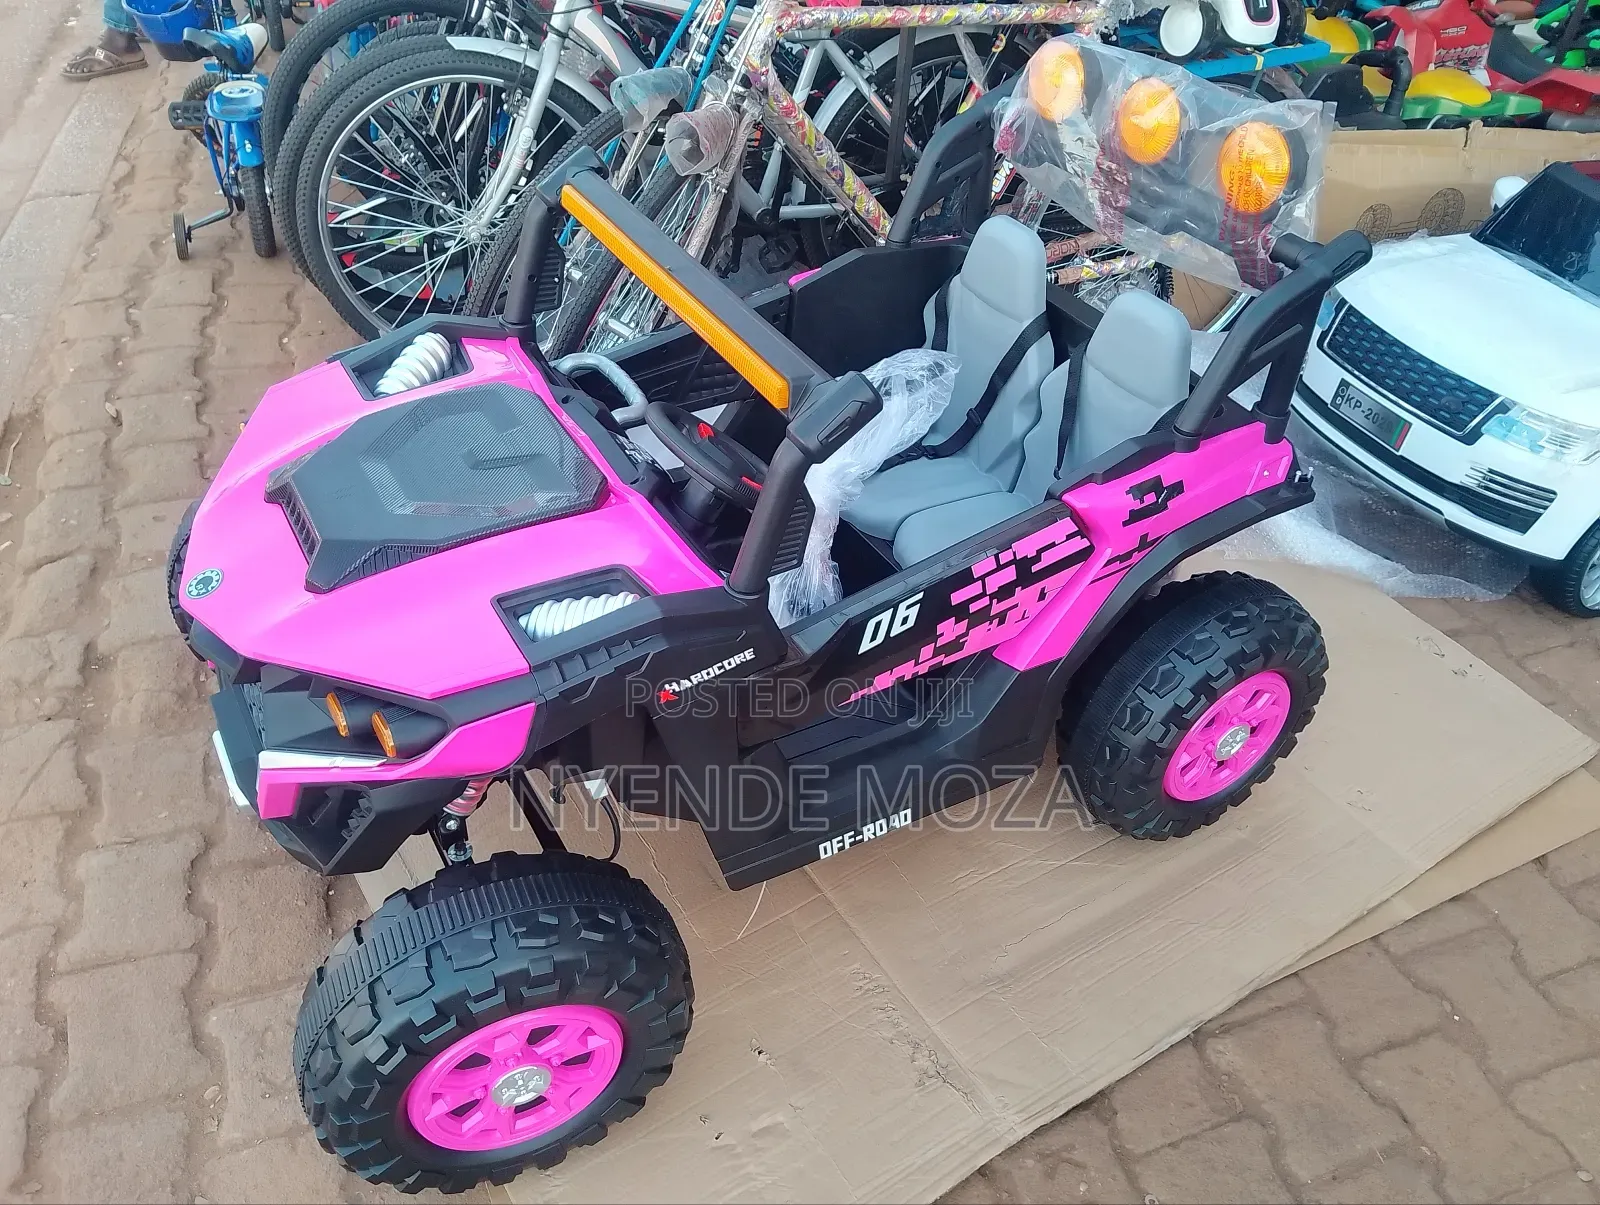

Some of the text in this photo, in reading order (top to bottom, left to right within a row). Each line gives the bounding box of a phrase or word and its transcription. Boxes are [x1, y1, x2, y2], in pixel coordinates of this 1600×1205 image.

[858, 591, 924, 655] 06
[664, 648, 756, 693] HARDCORE
[819, 808, 912, 860] OFF-ROAD
